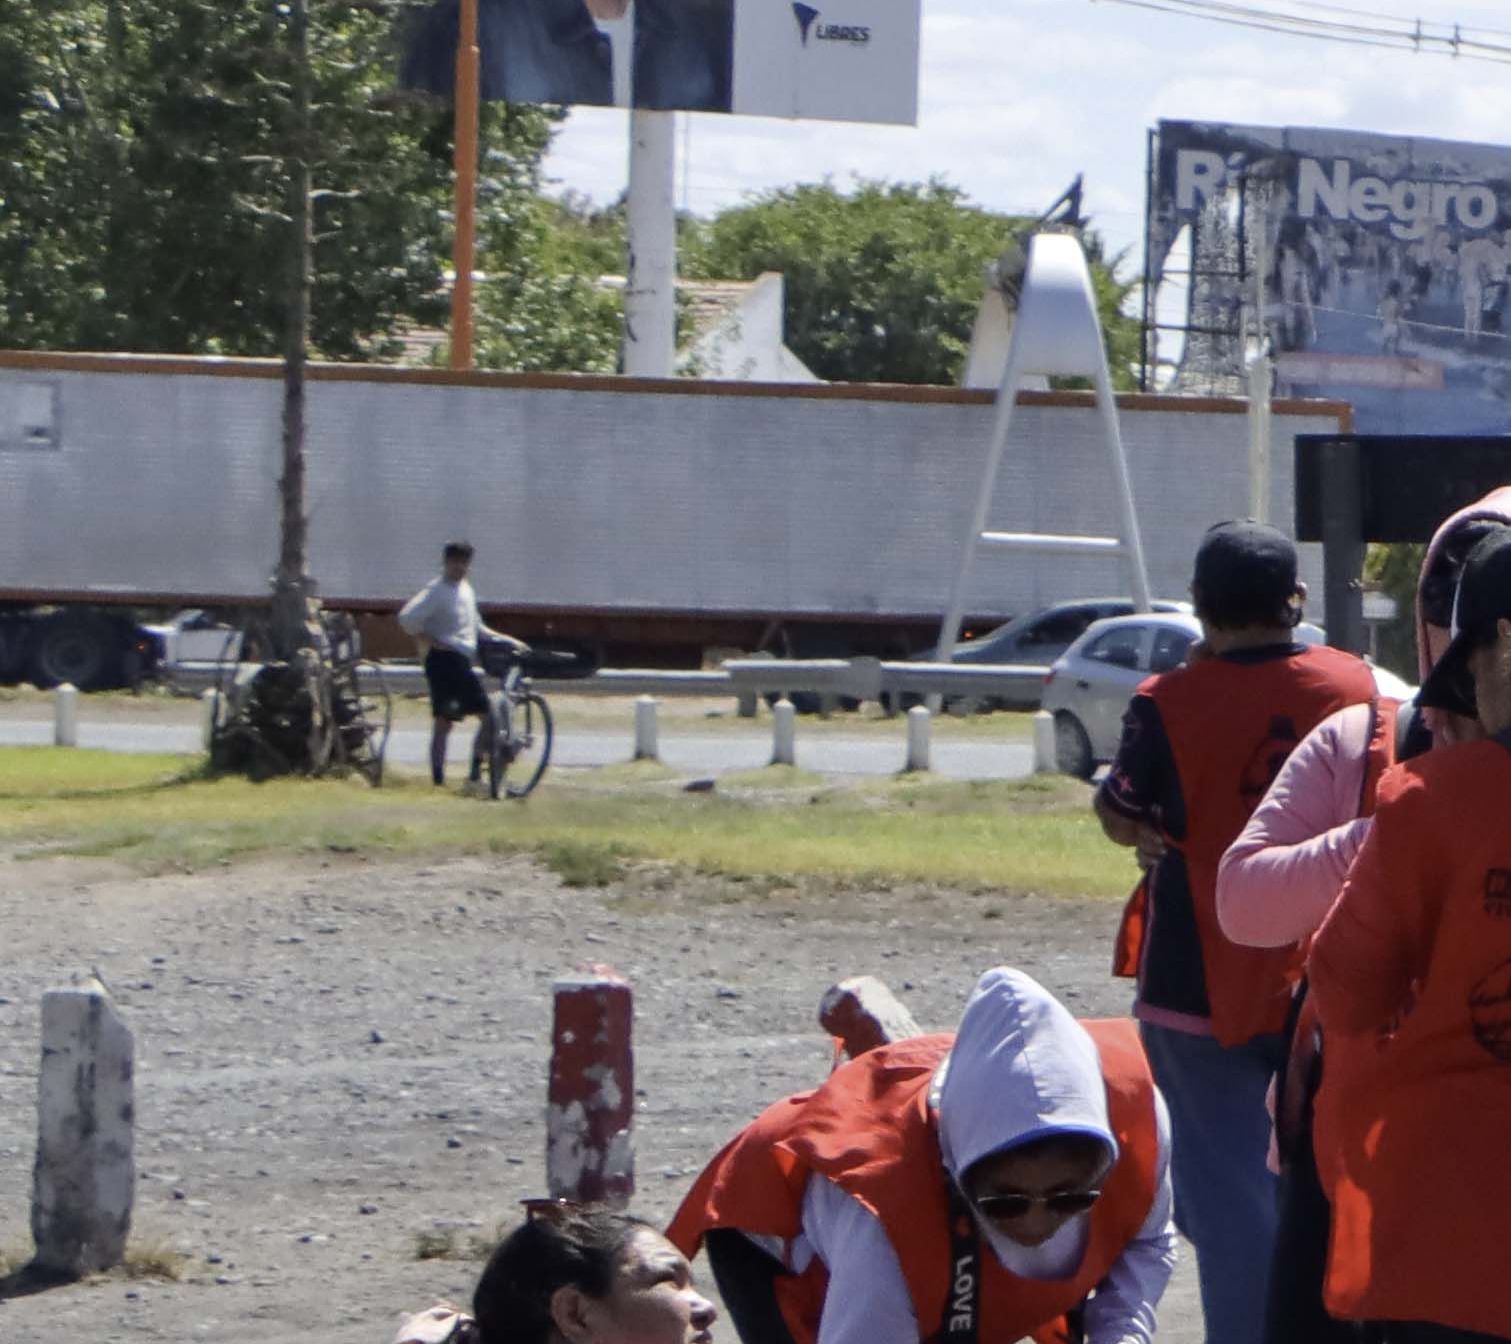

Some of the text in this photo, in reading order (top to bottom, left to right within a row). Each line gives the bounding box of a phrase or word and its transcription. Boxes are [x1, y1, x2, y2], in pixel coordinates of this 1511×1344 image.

[816, 24, 870, 43] LIBRES
[1298, 158, 1497, 240] Negro
[950, 1254, 975, 1332] LOVE
